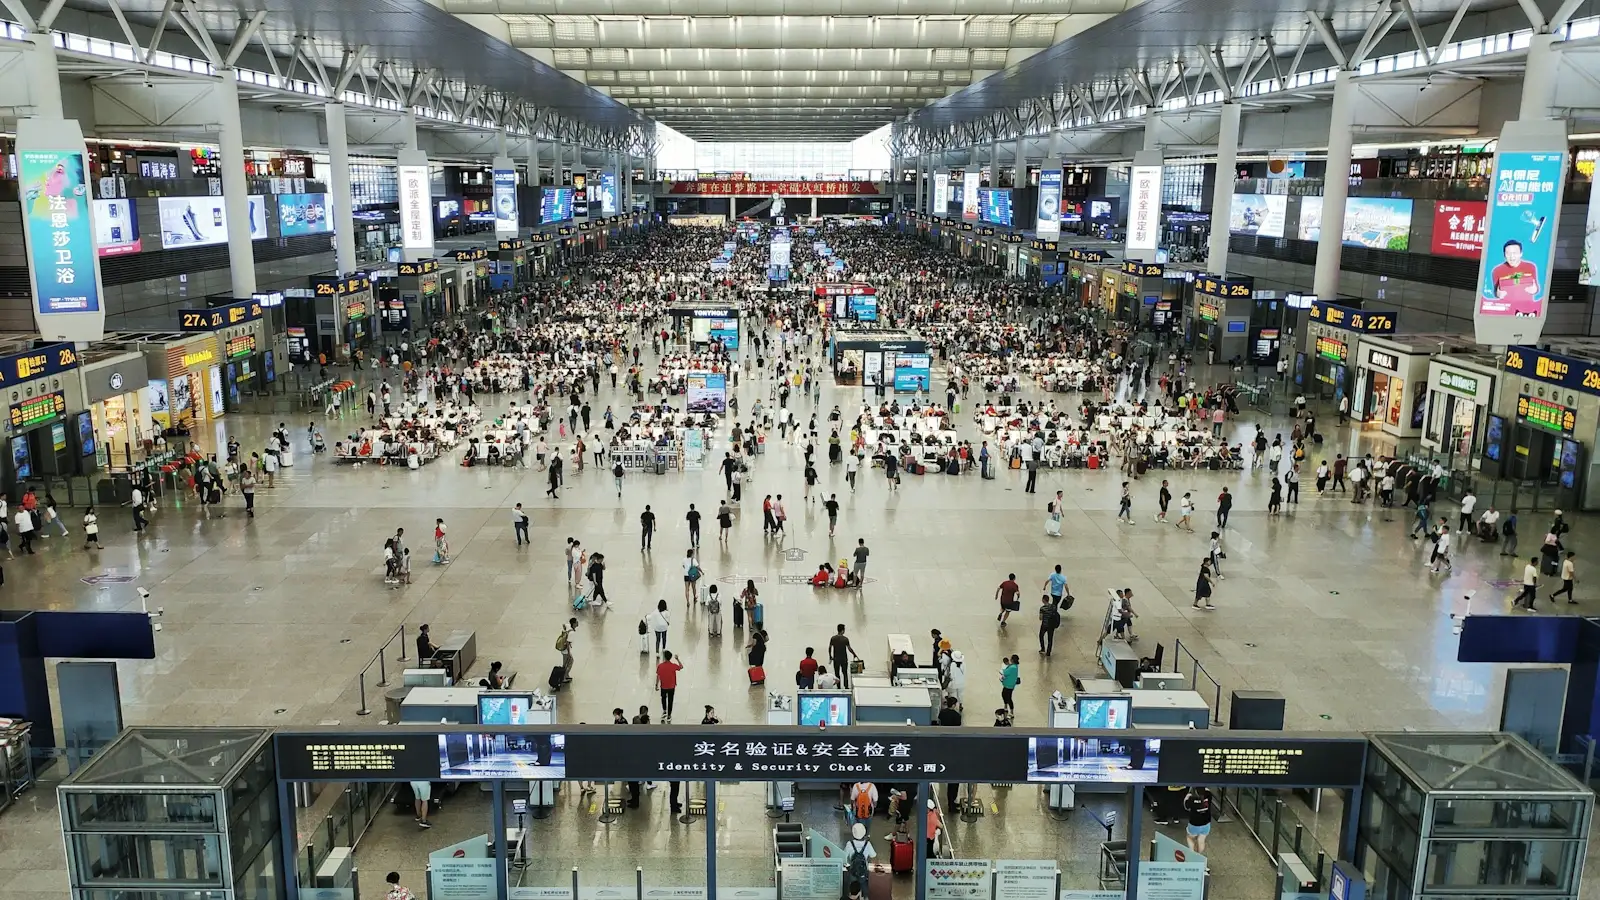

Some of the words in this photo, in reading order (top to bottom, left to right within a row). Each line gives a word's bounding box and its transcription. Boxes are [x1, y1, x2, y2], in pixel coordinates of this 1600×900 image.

[409, 179, 422, 240] 欧派全屋定制
[1136, 180, 1151, 242] 欧派全屋定制
[48, 195, 75, 284] 法恩莎卫浴
[457, 252, 470, 260] 21A
[1088, 253, 1101, 261] 21B
[400, 266, 415, 274] 23A
[1146, 265, 1161, 275] 23B
[317, 284, 335, 294] 25A
[1231, 285, 1249, 296] 25B
[184, 314, 208, 327] 27A
[211, 312, 223, 326] 27A
[1351, 314, 1363, 329] 27B
[1367, 316, 1391, 330] 27B
[59, 349, 76, 366] 28A
[1506, 351, 1523, 369] 28B
[694, 741, 912, 757] 实名验证&安全检查
[658, 762, 726, 773] Identity
[735, 763, 743, 771] &
[752, 762, 820, 773] Security
[829, 763, 872, 772] Check
